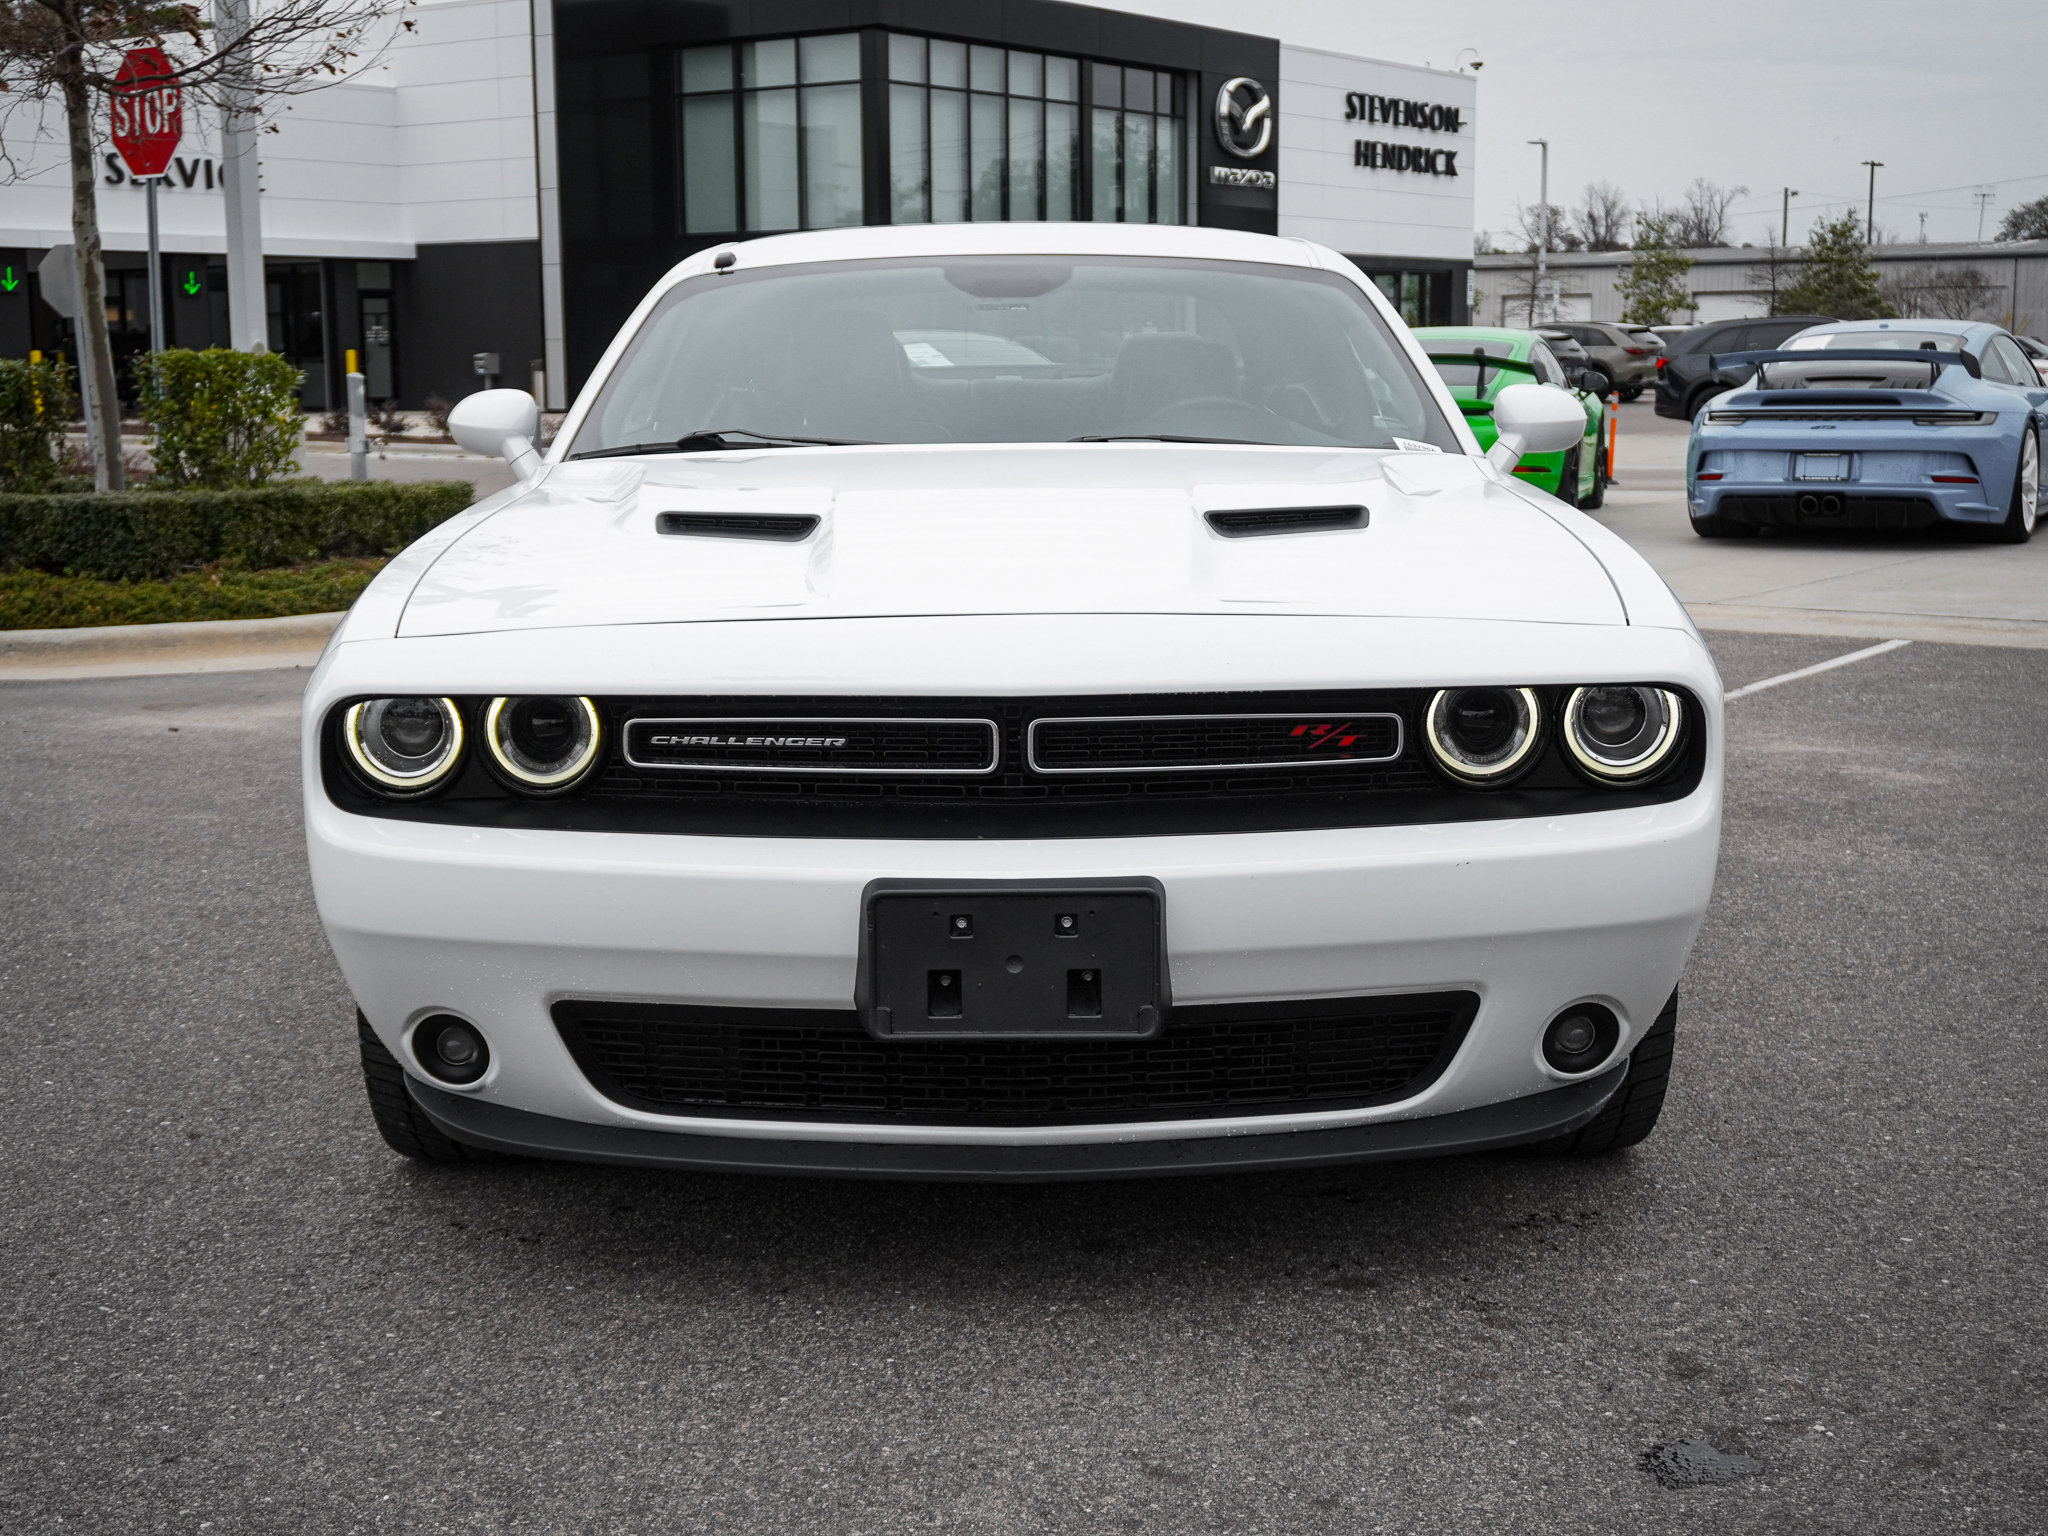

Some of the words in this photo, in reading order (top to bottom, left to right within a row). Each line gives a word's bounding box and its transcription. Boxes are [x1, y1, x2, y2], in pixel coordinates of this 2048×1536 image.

[114, 88, 178, 137] STOP
[1354, 139, 1459, 176] HENDRICK
[650, 736, 846, 746] CHALLENGER
[1289, 722, 1367, 749] R/T
